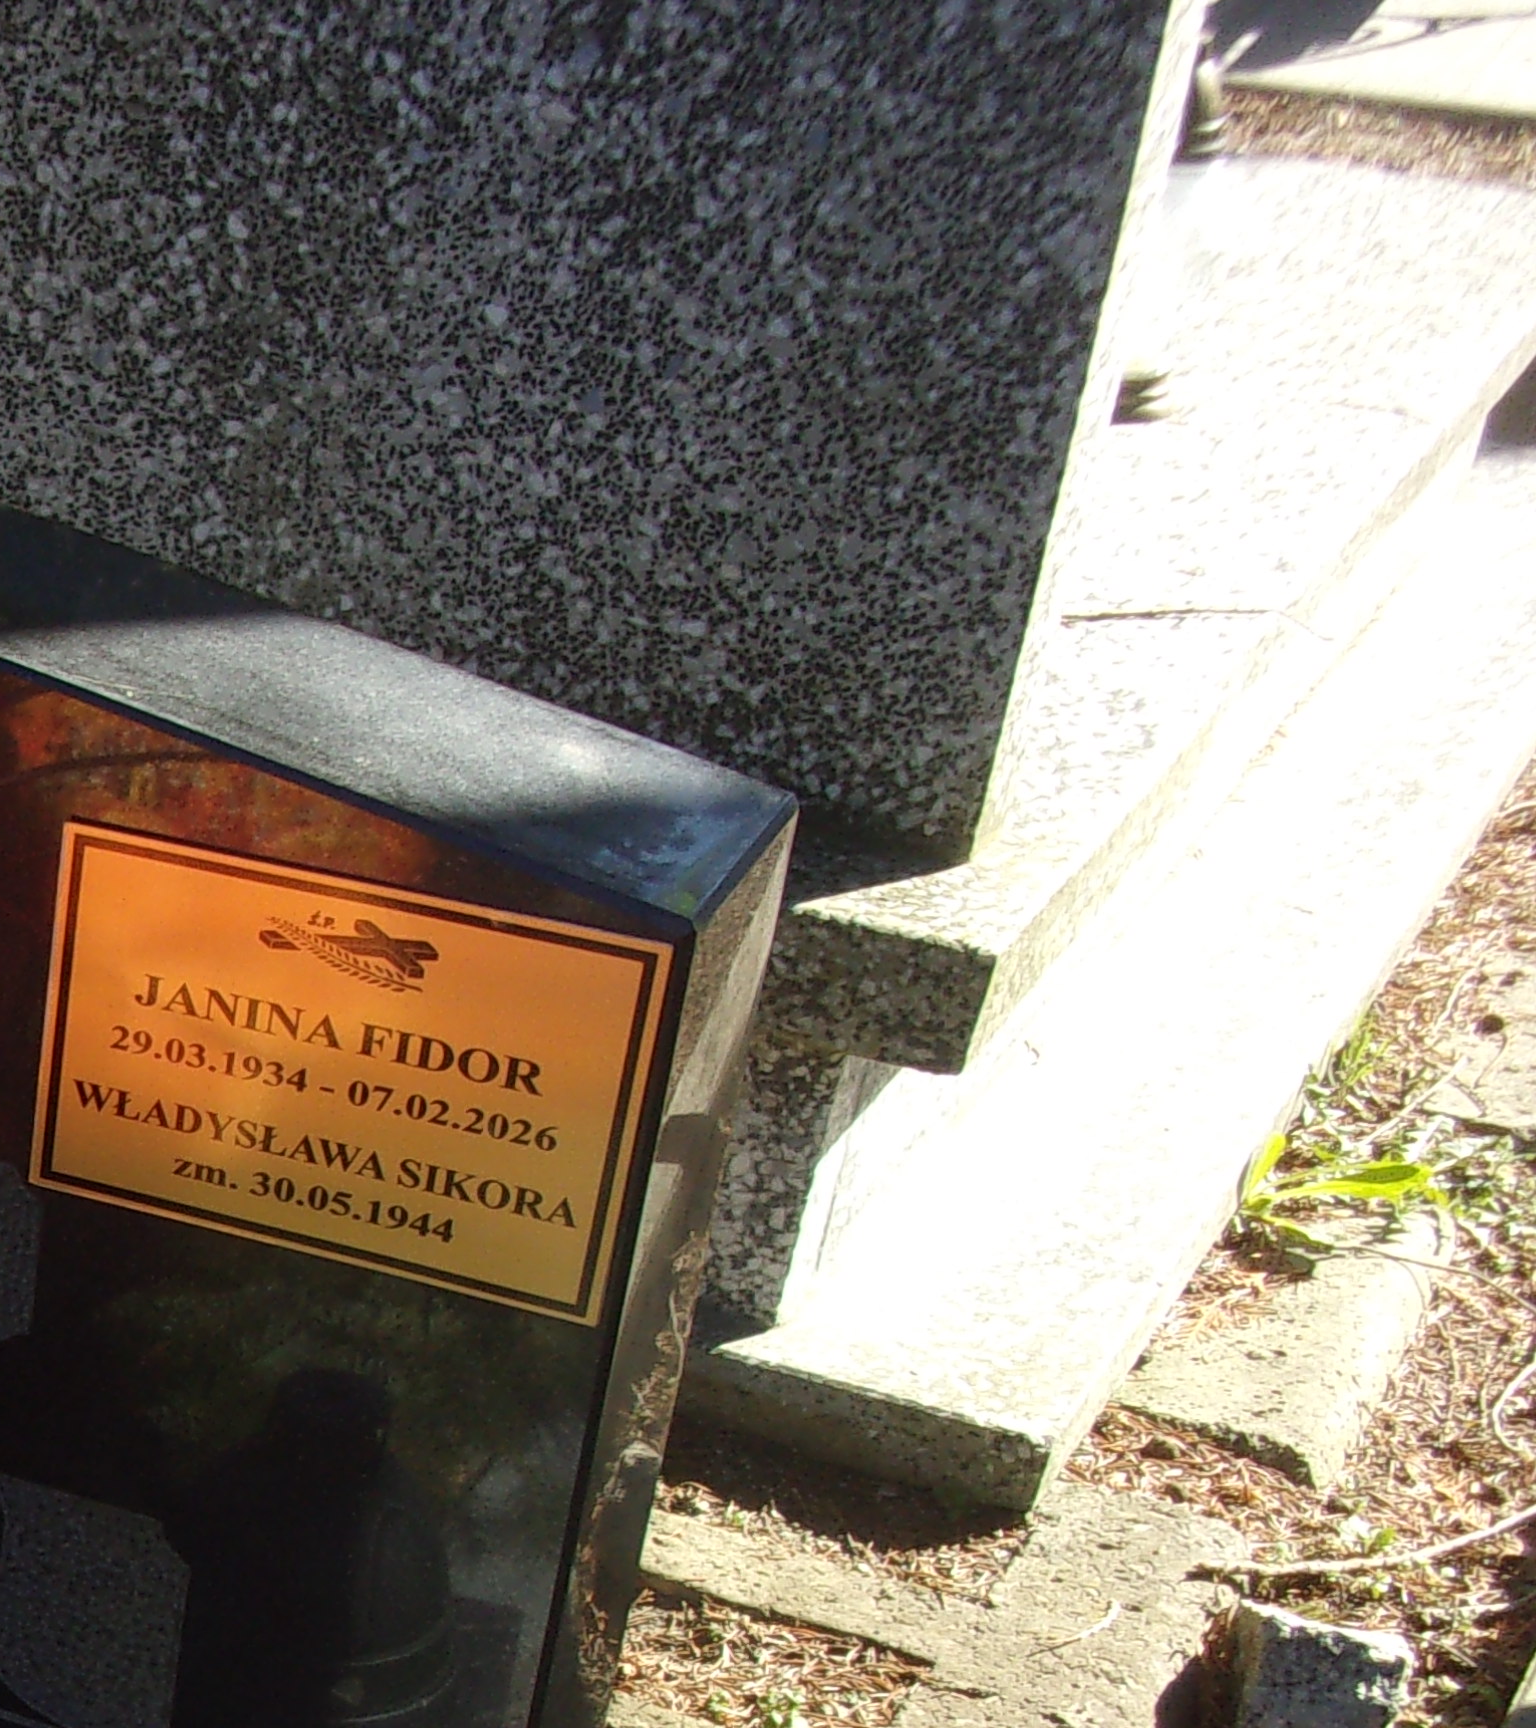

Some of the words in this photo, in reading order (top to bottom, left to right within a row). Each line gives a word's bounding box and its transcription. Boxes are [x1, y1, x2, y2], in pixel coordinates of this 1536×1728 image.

[109, 1025, 308, 1093] 29.03.1934
[346, 1078, 559, 1152] 07.02.2026
[133, 973, 339, 1050] JANINA
[356, 1022, 544, 1096] FIDOR
[72, 1078, 384, 1181] WŁADYSŁAWA
[396, 1157, 578, 1229] SIKORA
[172, 1157, 237, 1190] zm.
[249, 1171, 455, 1243] 30.05.1944
